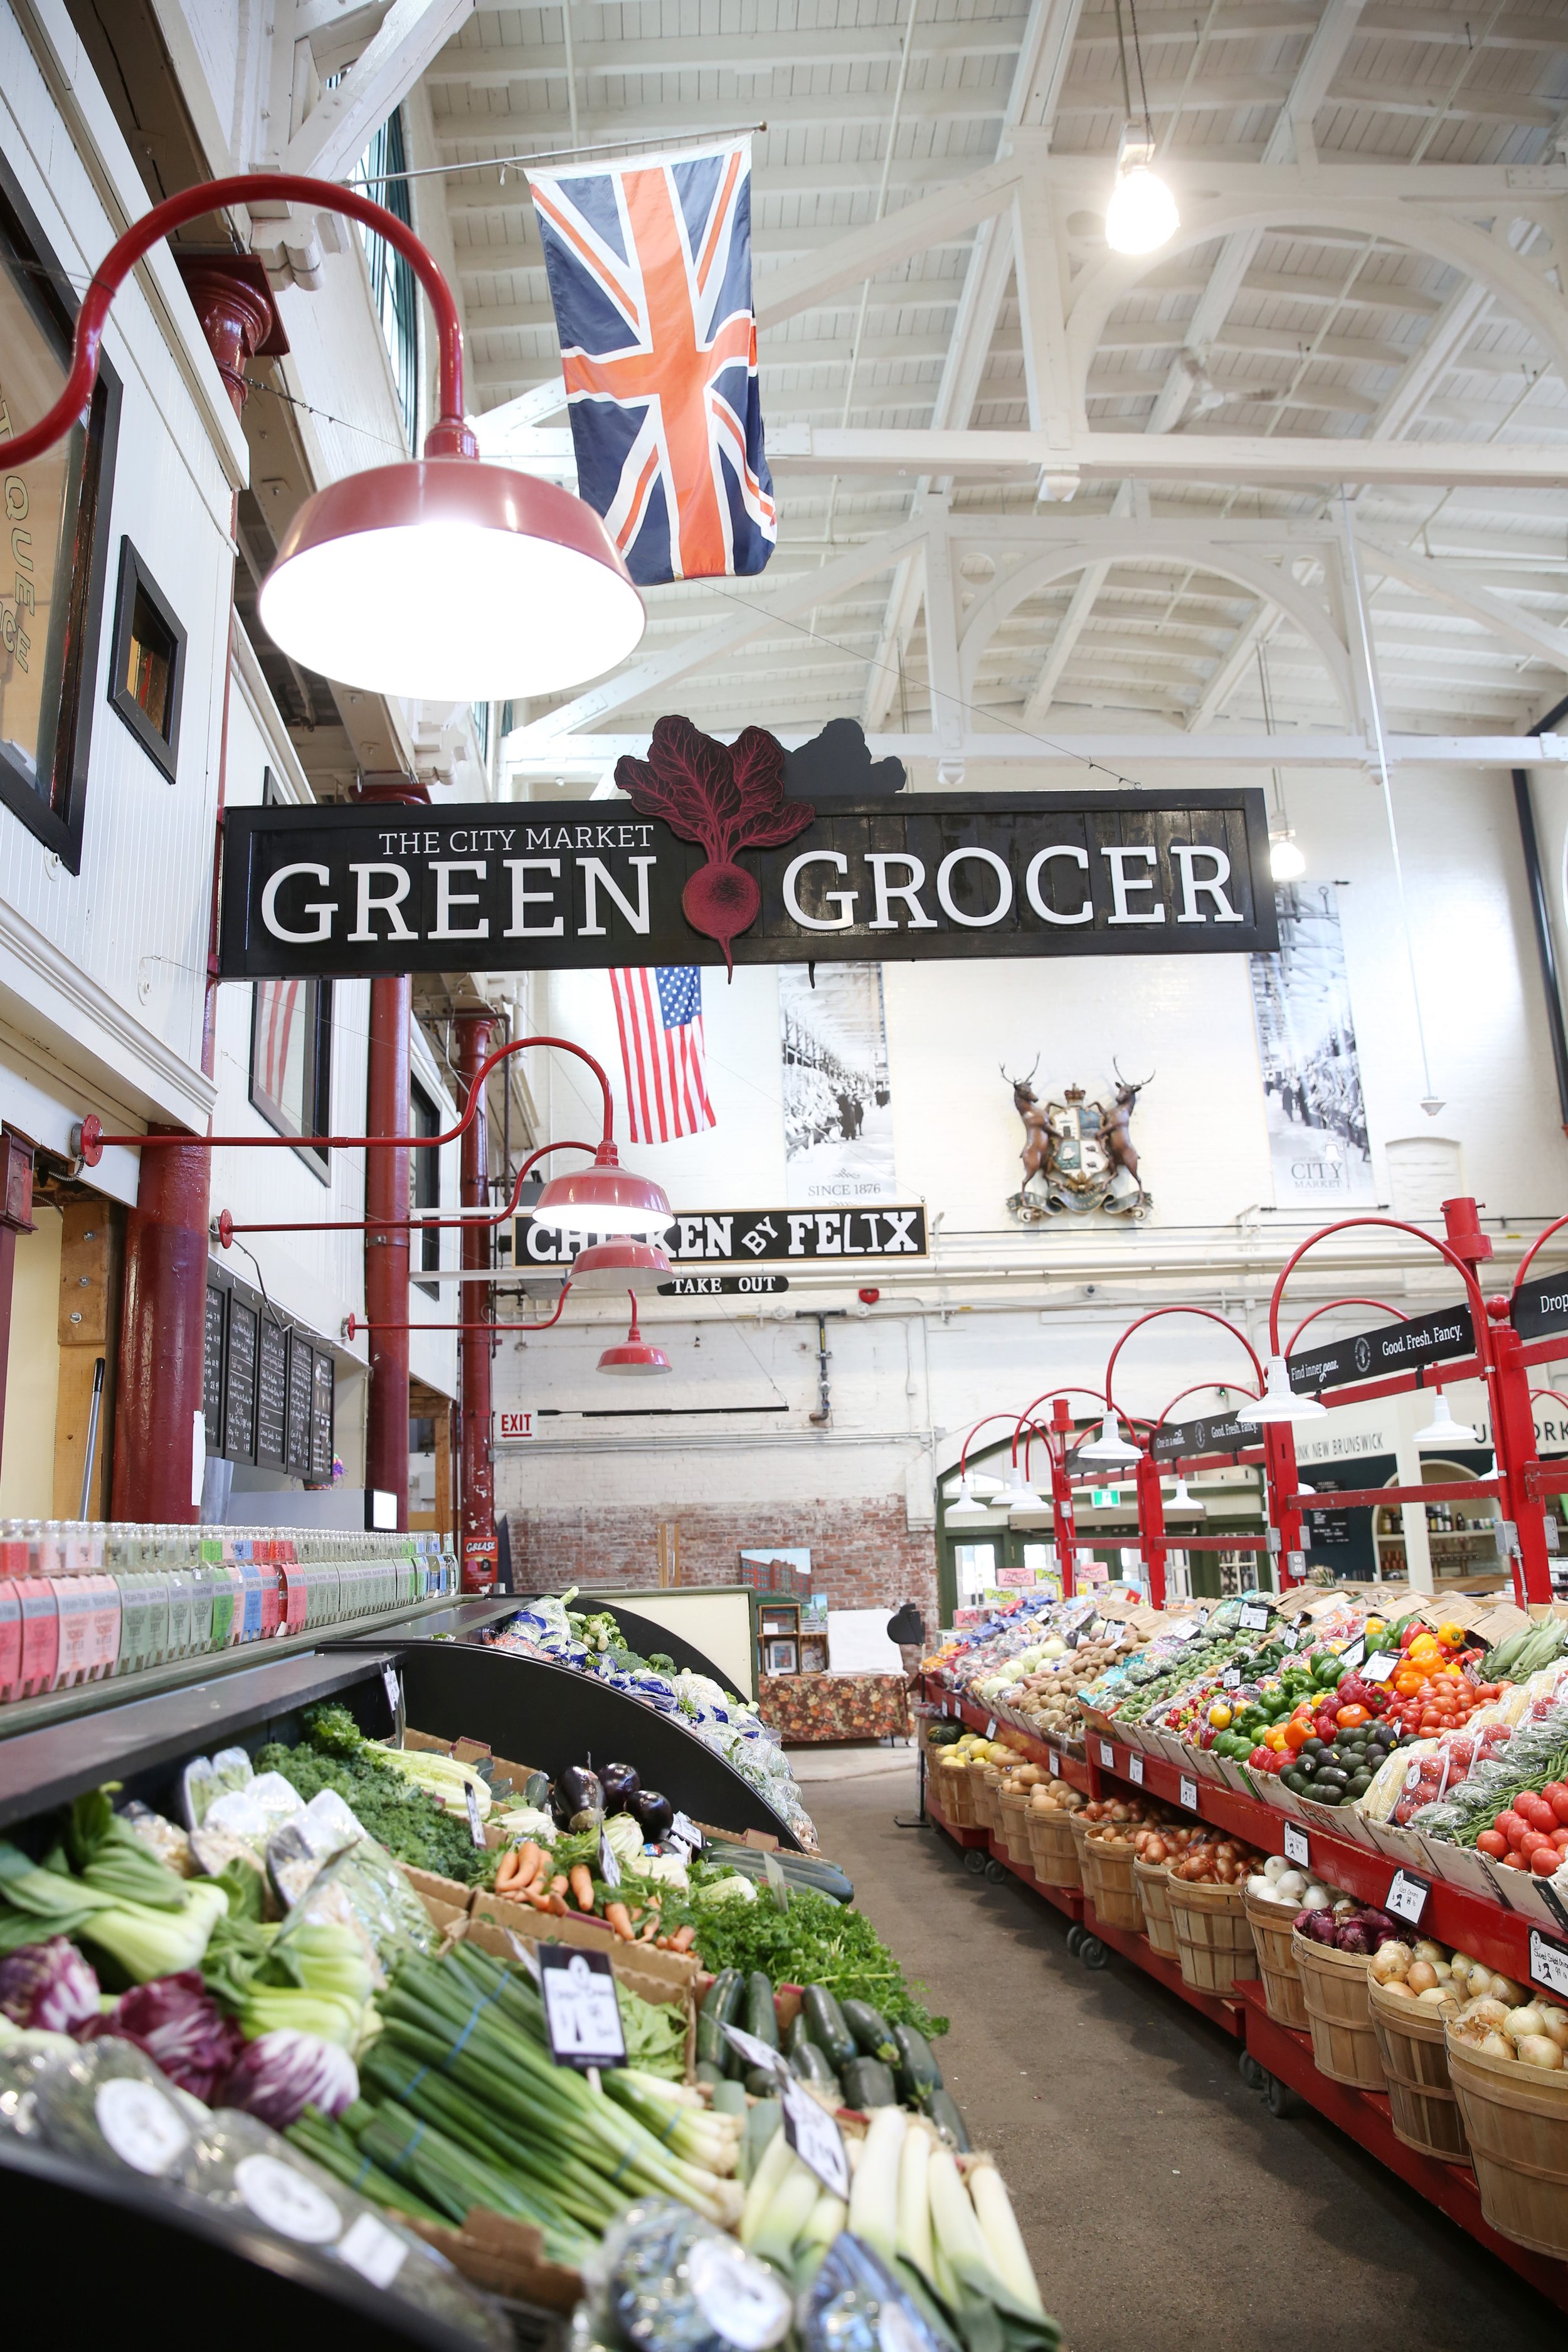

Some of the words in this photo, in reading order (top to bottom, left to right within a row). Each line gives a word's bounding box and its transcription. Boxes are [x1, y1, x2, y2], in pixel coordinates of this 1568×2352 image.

[379, 832, 440, 856] THE
[450, 829, 516, 853] CITY
[526, 825, 654, 850] MARKET
[260, 856, 657, 943] GREEN
[782, 845, 1244, 931] GROCER
[1291, 1162, 1343, 1179] CITY
[808, 1184, 850, 1197] SINCE
[854, 1182, 881, 1195] 1876
[1294, 1180, 1342, 1189] MARKET
[741, 1216, 778, 1256] BY
[787, 1211, 919, 1255] FELIX
[672, 1277, 723, 1293] TAKE
[738, 1275, 776, 1293] OUT
[1382, 1337, 1406, 1357] Good.
[1406, 1329, 1433, 1350] Fresh.
[1433, 1324, 1463, 1342] Fancy.
[1290, 1365, 1305, 1381] Find
[1305, 1362, 1322, 1378] inner
[501, 1414, 532, 1432] EXIT
[1211, 1425, 1224, 1438] Good.
[1226, 1423, 1241, 1436] Fresh.
[1312, 1441, 1330, 1458] NEW
[1333, 1433, 1384, 1455] BRUNSWICK
[466, 1542, 495, 1552] GREASE
